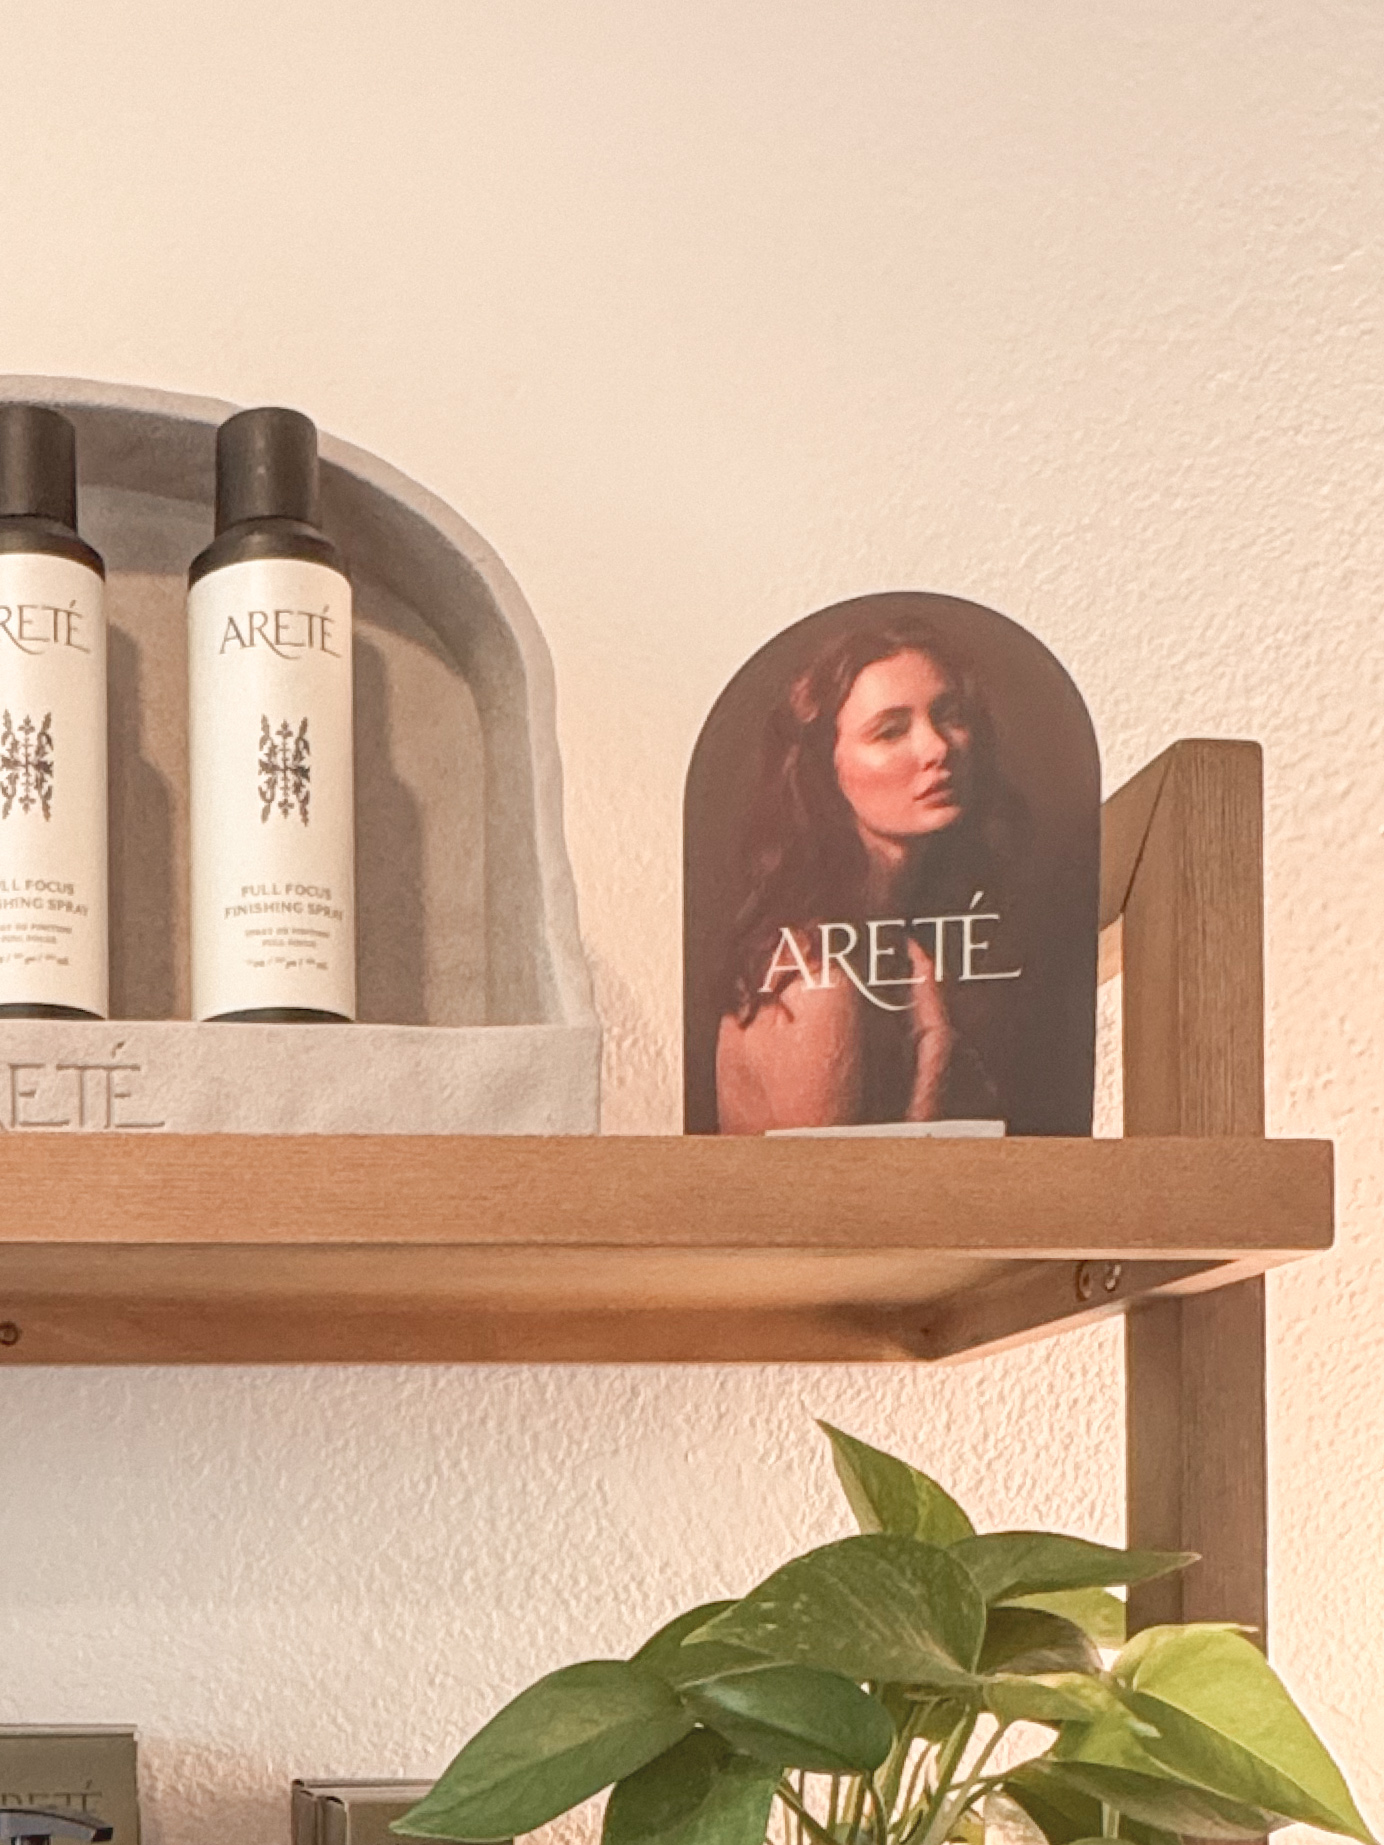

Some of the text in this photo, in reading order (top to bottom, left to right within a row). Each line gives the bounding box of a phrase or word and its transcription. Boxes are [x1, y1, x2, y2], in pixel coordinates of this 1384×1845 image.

[219, 604, 342, 660] ARETÉ
[25, 879, 74, 896] FOCUS
[241, 882, 332, 901] FULL FOCUS
[223, 901, 304, 919] FINISHING
[758, 890, 1022, 1012] ARETÉ
